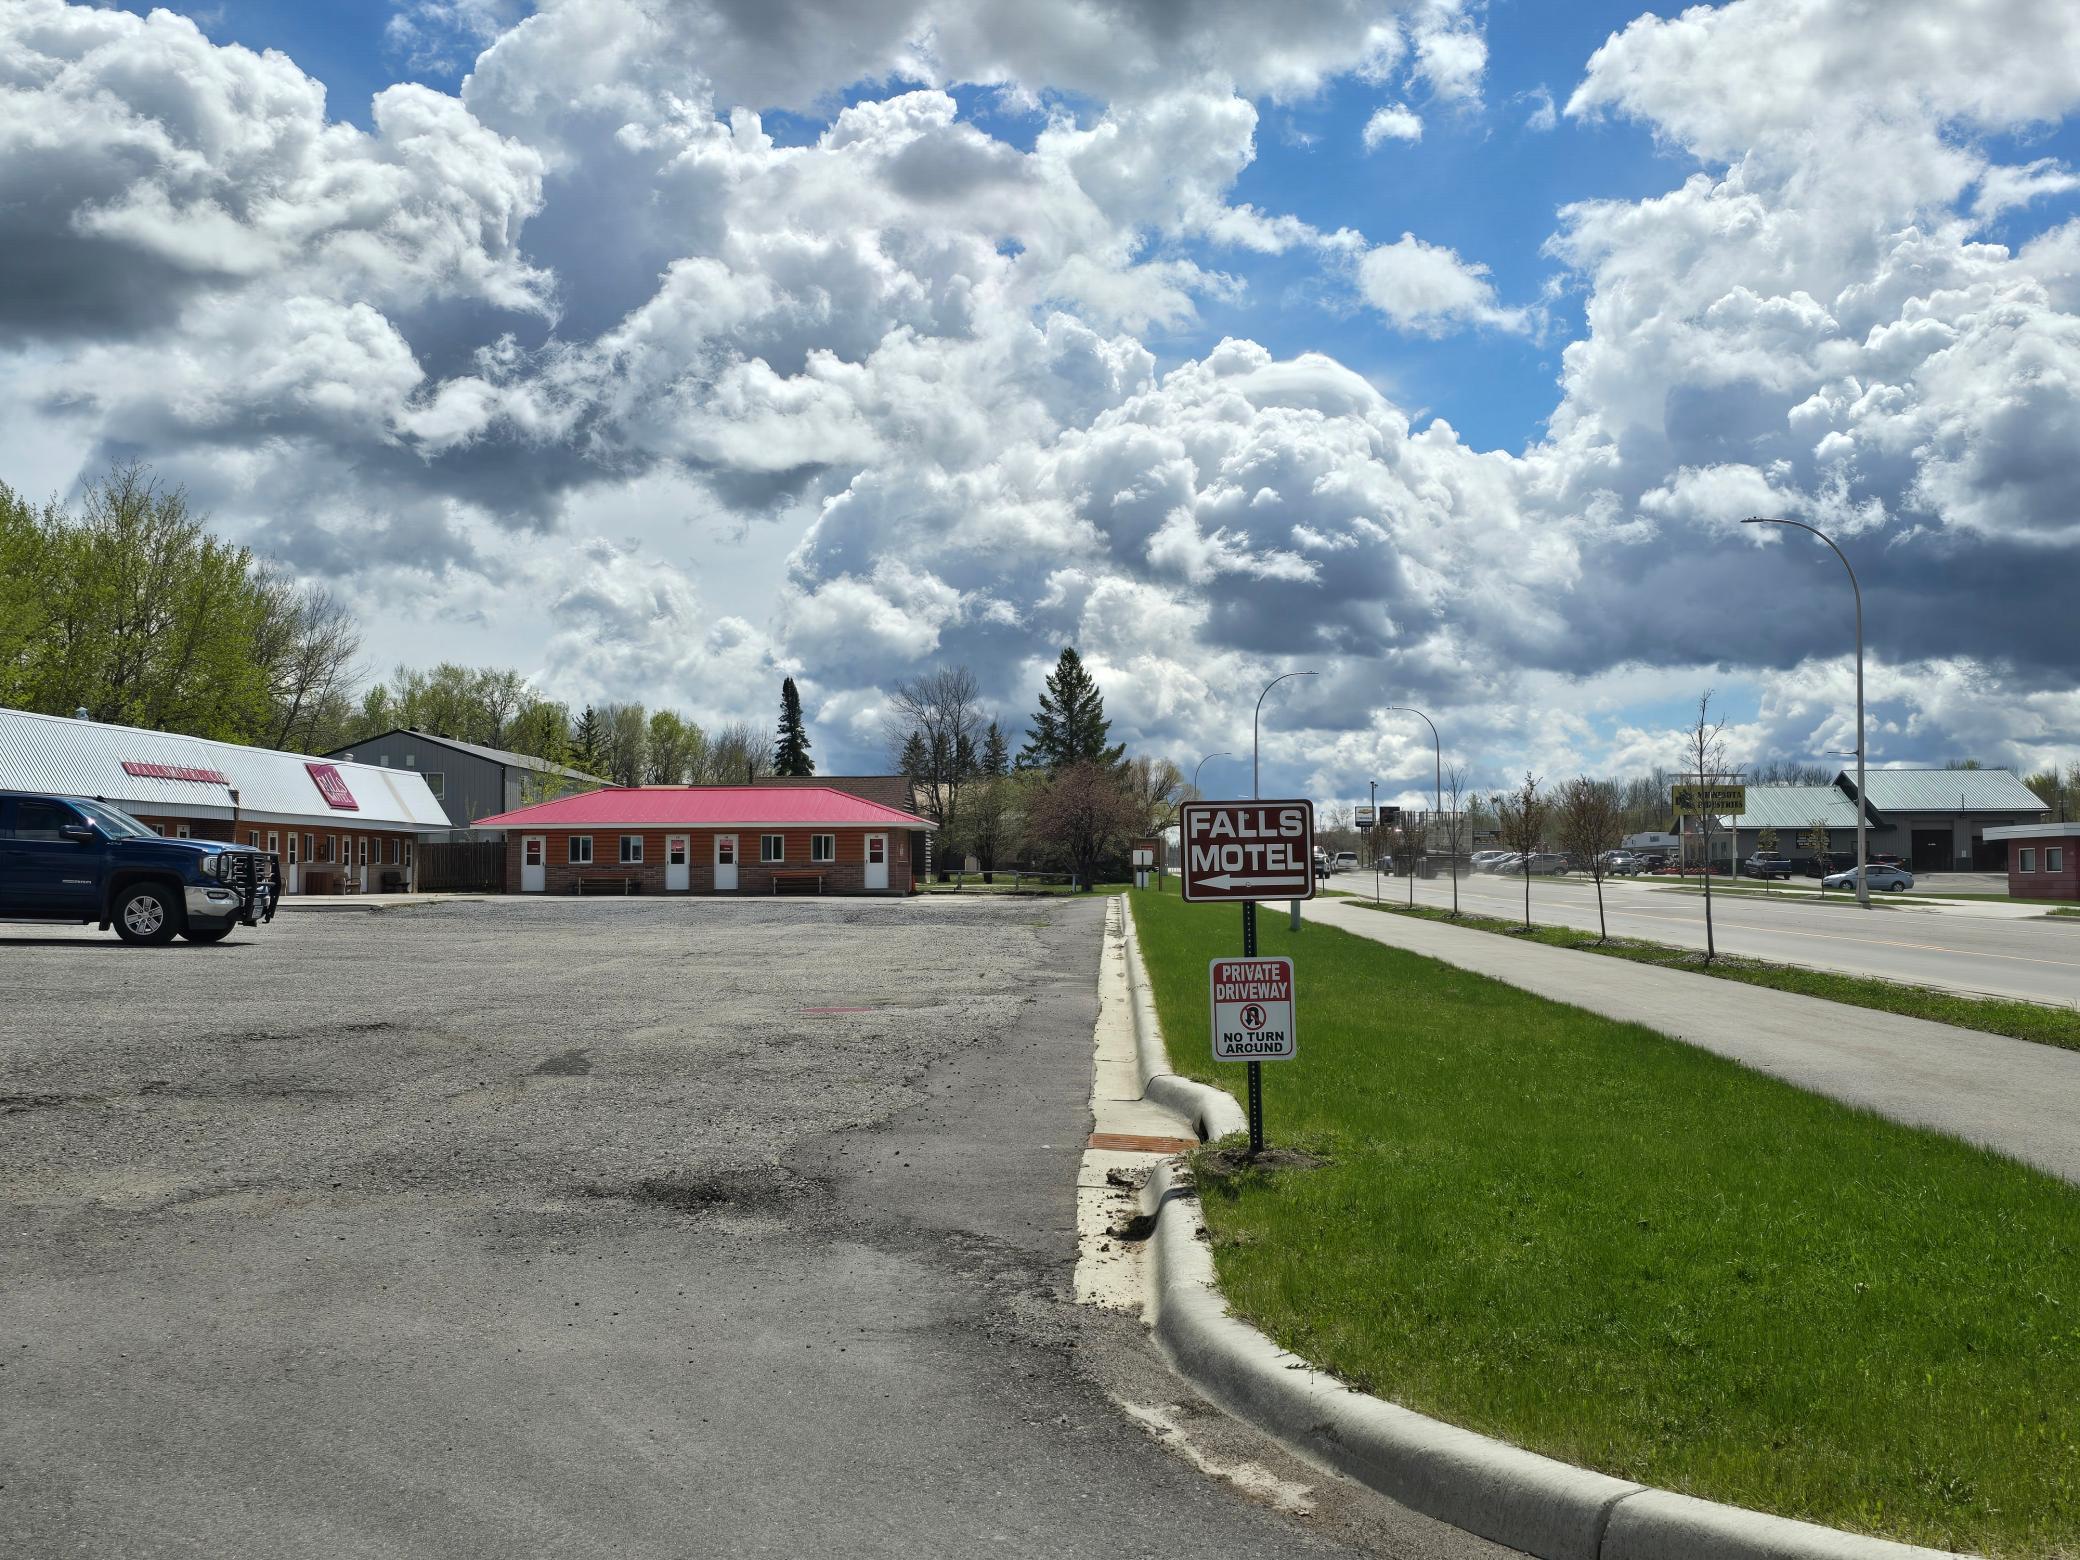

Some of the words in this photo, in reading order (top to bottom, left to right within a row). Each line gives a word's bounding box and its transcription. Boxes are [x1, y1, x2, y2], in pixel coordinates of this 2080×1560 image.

[1190, 809, 1303, 839] FALLS
[1191, 843, 1305, 872] MOTEL
[1222, 963, 1281, 982] PRIVATE
[1216, 982, 1288, 1000] DRIVEWAY
[1223, 1032, 1243, 1043] NO
[1246, 1031, 1285, 1042] TURN
[1225, 1042, 1283, 1054] AROUND
